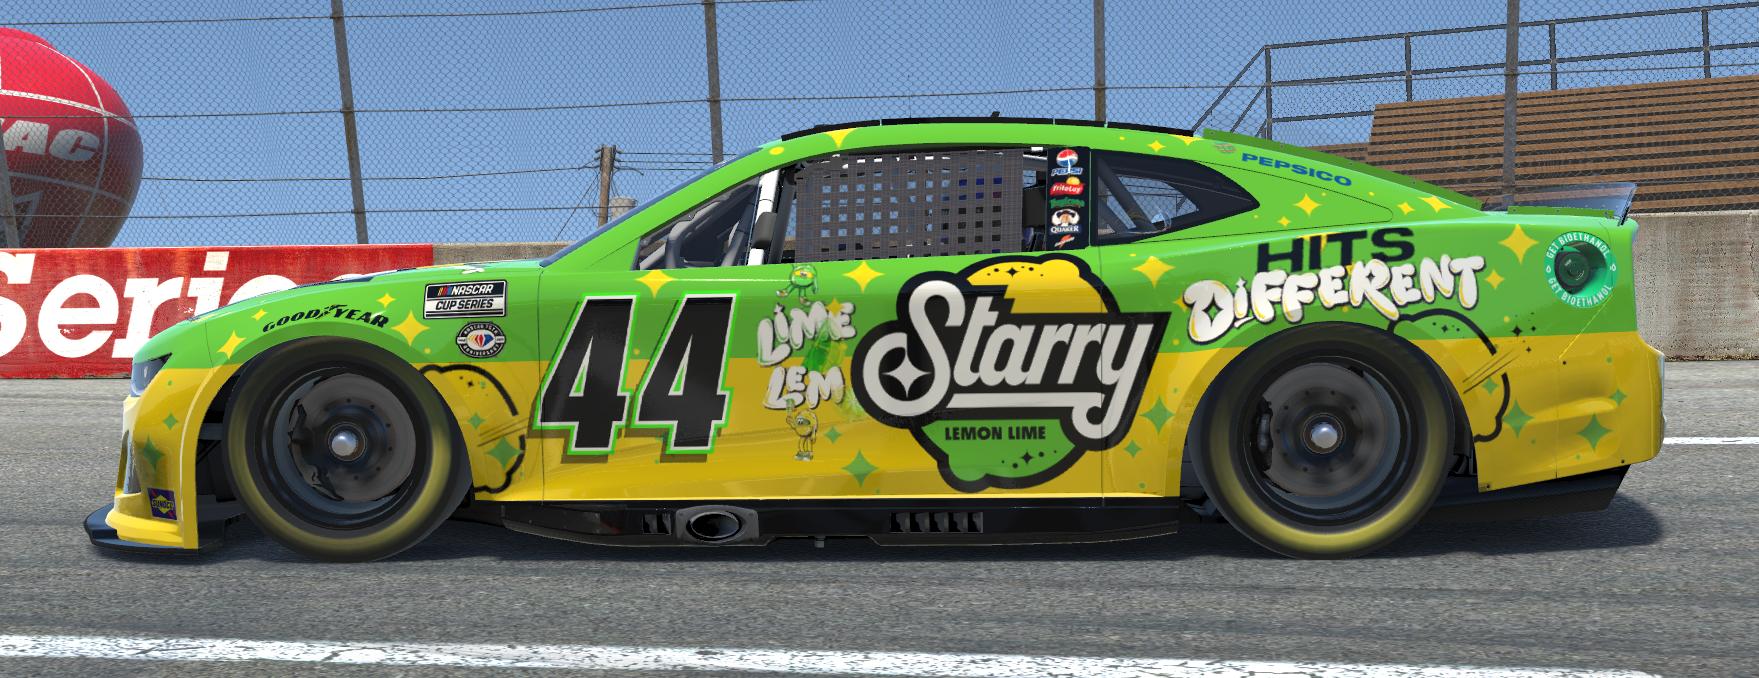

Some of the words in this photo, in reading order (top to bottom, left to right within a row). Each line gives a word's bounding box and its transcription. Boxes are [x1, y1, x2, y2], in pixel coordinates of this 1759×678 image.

[0, 118, 100, 161] AC
[1241, 152, 1352, 186] PEPSICO
[1051, 225, 1079, 233] QUAKER
[1256, 227, 1416, 273] HITS
[1546, 242, 1559, 259] GET
[1558, 232, 1610, 258] BIOETHANOL
[451, 284, 494, 295] NASCAR
[1548, 278, 1562, 293] GET
[1561, 285, 1613, 307] BIOETHANOL
[262, 304, 389, 333] GOODYEAR
[436, 301, 457, 310] CUP
[458, 299, 494, 309] SERIES
[538, 294, 737, 451] 44
[863, 280, 1154, 439] Starry
[763, 366, 845, 410] LEM
[945, 427, 1003, 440] LEMON
[1009, 426, 1046, 440] LIME
